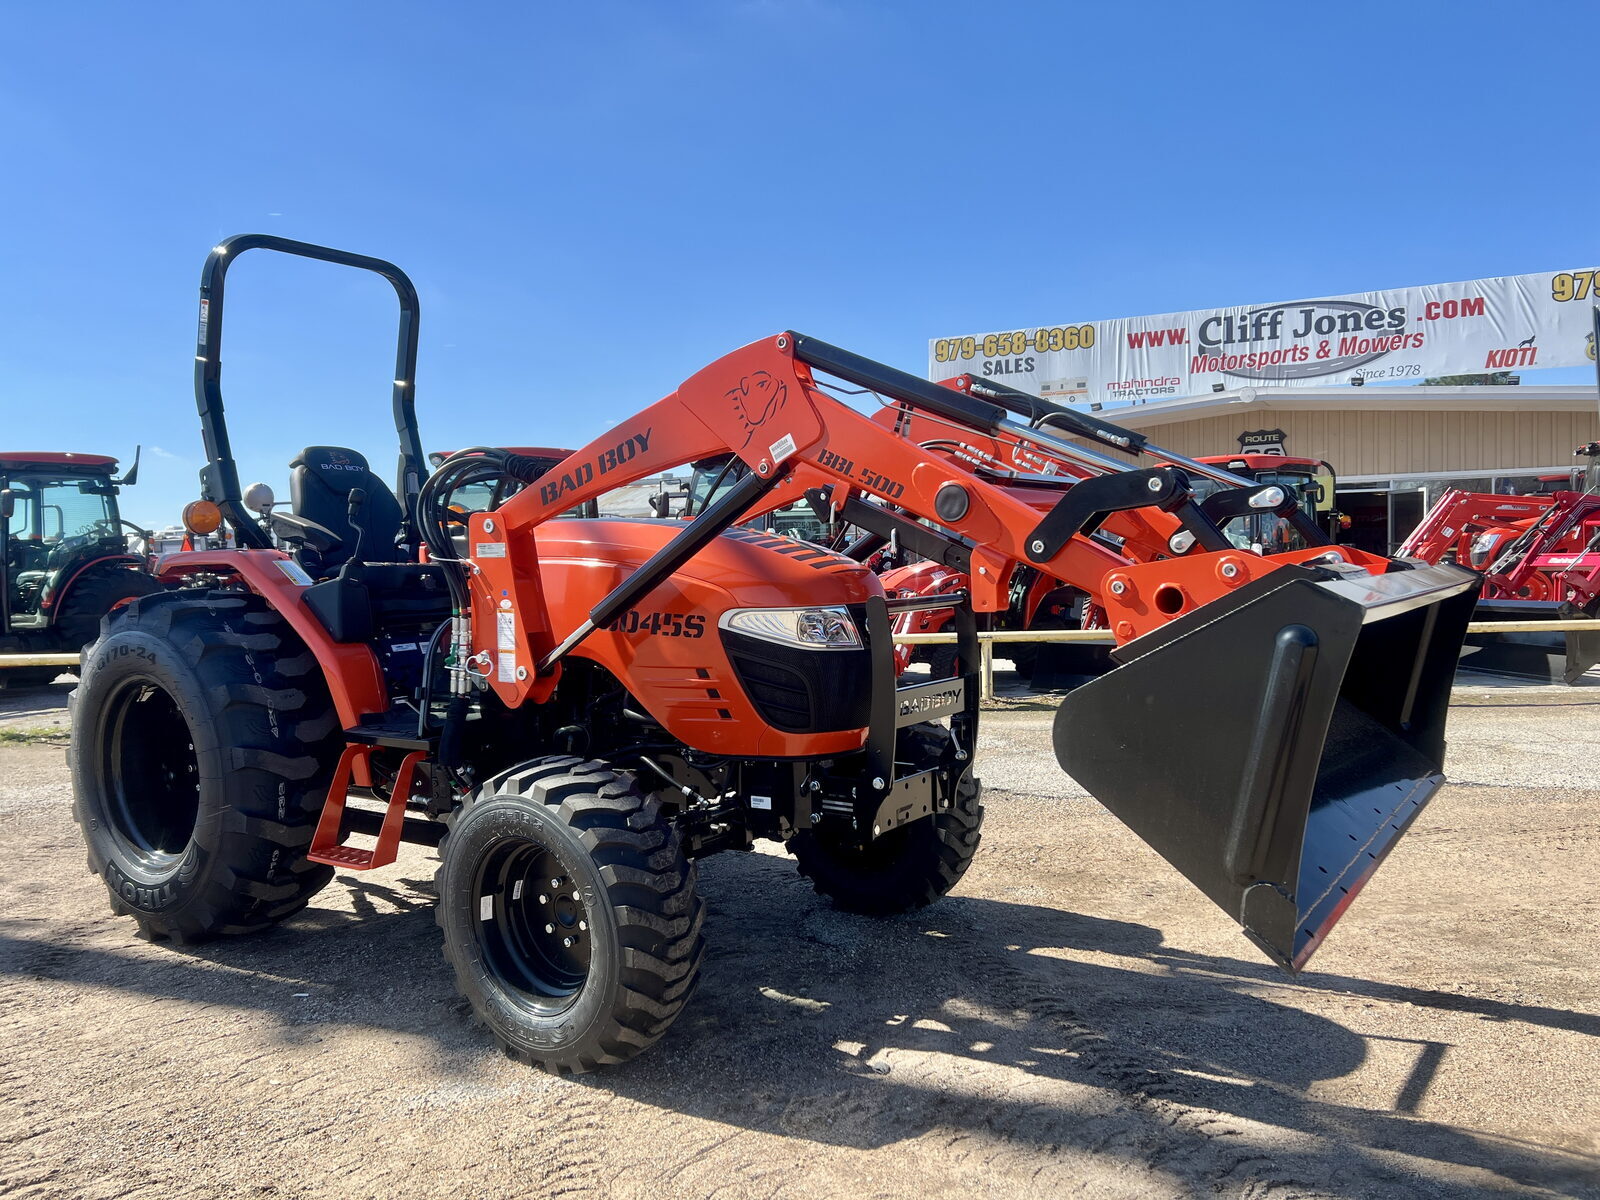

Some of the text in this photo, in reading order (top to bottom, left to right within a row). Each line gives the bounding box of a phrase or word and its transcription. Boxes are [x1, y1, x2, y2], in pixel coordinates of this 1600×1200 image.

[1199, 310, 1284, 346] Cliff
[1293, 307, 1405, 339] Jones
[1416, 297, 1485, 322] .COM
[935, 325, 1095, 362] 979-658-8360
[1190, 330, 1424, 375] Motorsports & Mowers
[982, 356, 1035, 377] SALES
[1484, 347, 1538, 369] KIOTI
[1355, 364, 1422, 379] Since 1978
[1107, 376, 1181, 390] mahindra
[1112, 386, 1176, 398] TRACTORS
[1245, 434, 1280, 443] ROUTE
[320, 463, 364, 472] BAD BOY
[540, 427, 652, 506] BAD BOY
[817, 448, 854, 478] BBL
[858, 467, 905, 499] 500
[600, 611, 706, 638] 045S
